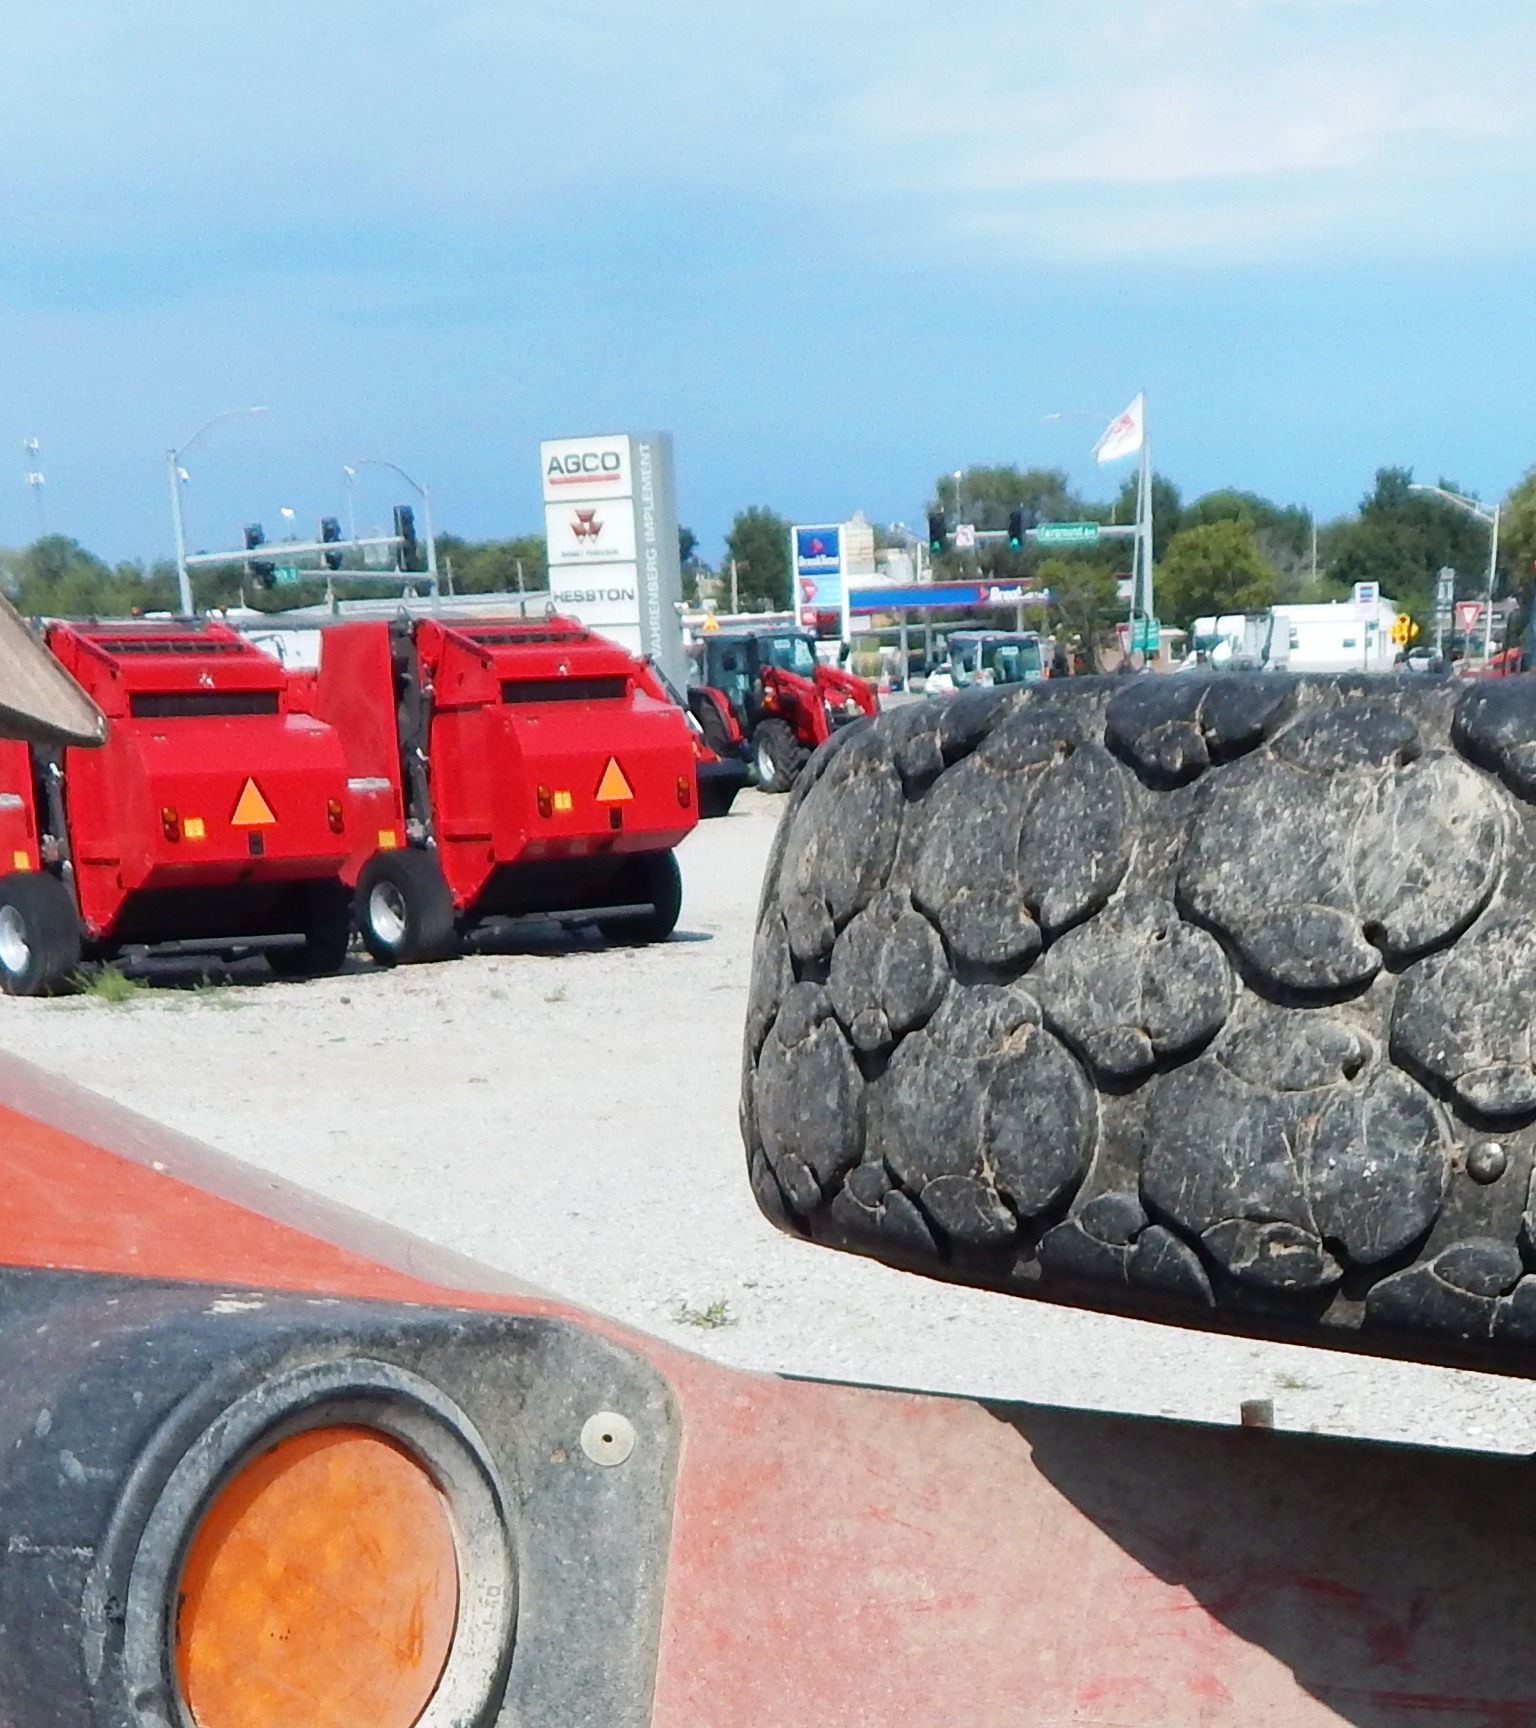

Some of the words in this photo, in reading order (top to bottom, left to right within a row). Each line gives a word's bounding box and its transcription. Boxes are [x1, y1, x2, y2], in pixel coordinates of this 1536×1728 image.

[547, 451, 621, 475] AGCO
[638, 442, 658, 542] IMPLEMENT
[554, 587, 635, 603] HESSTON
[645, 548, 662, 660] VAHRENBERG
